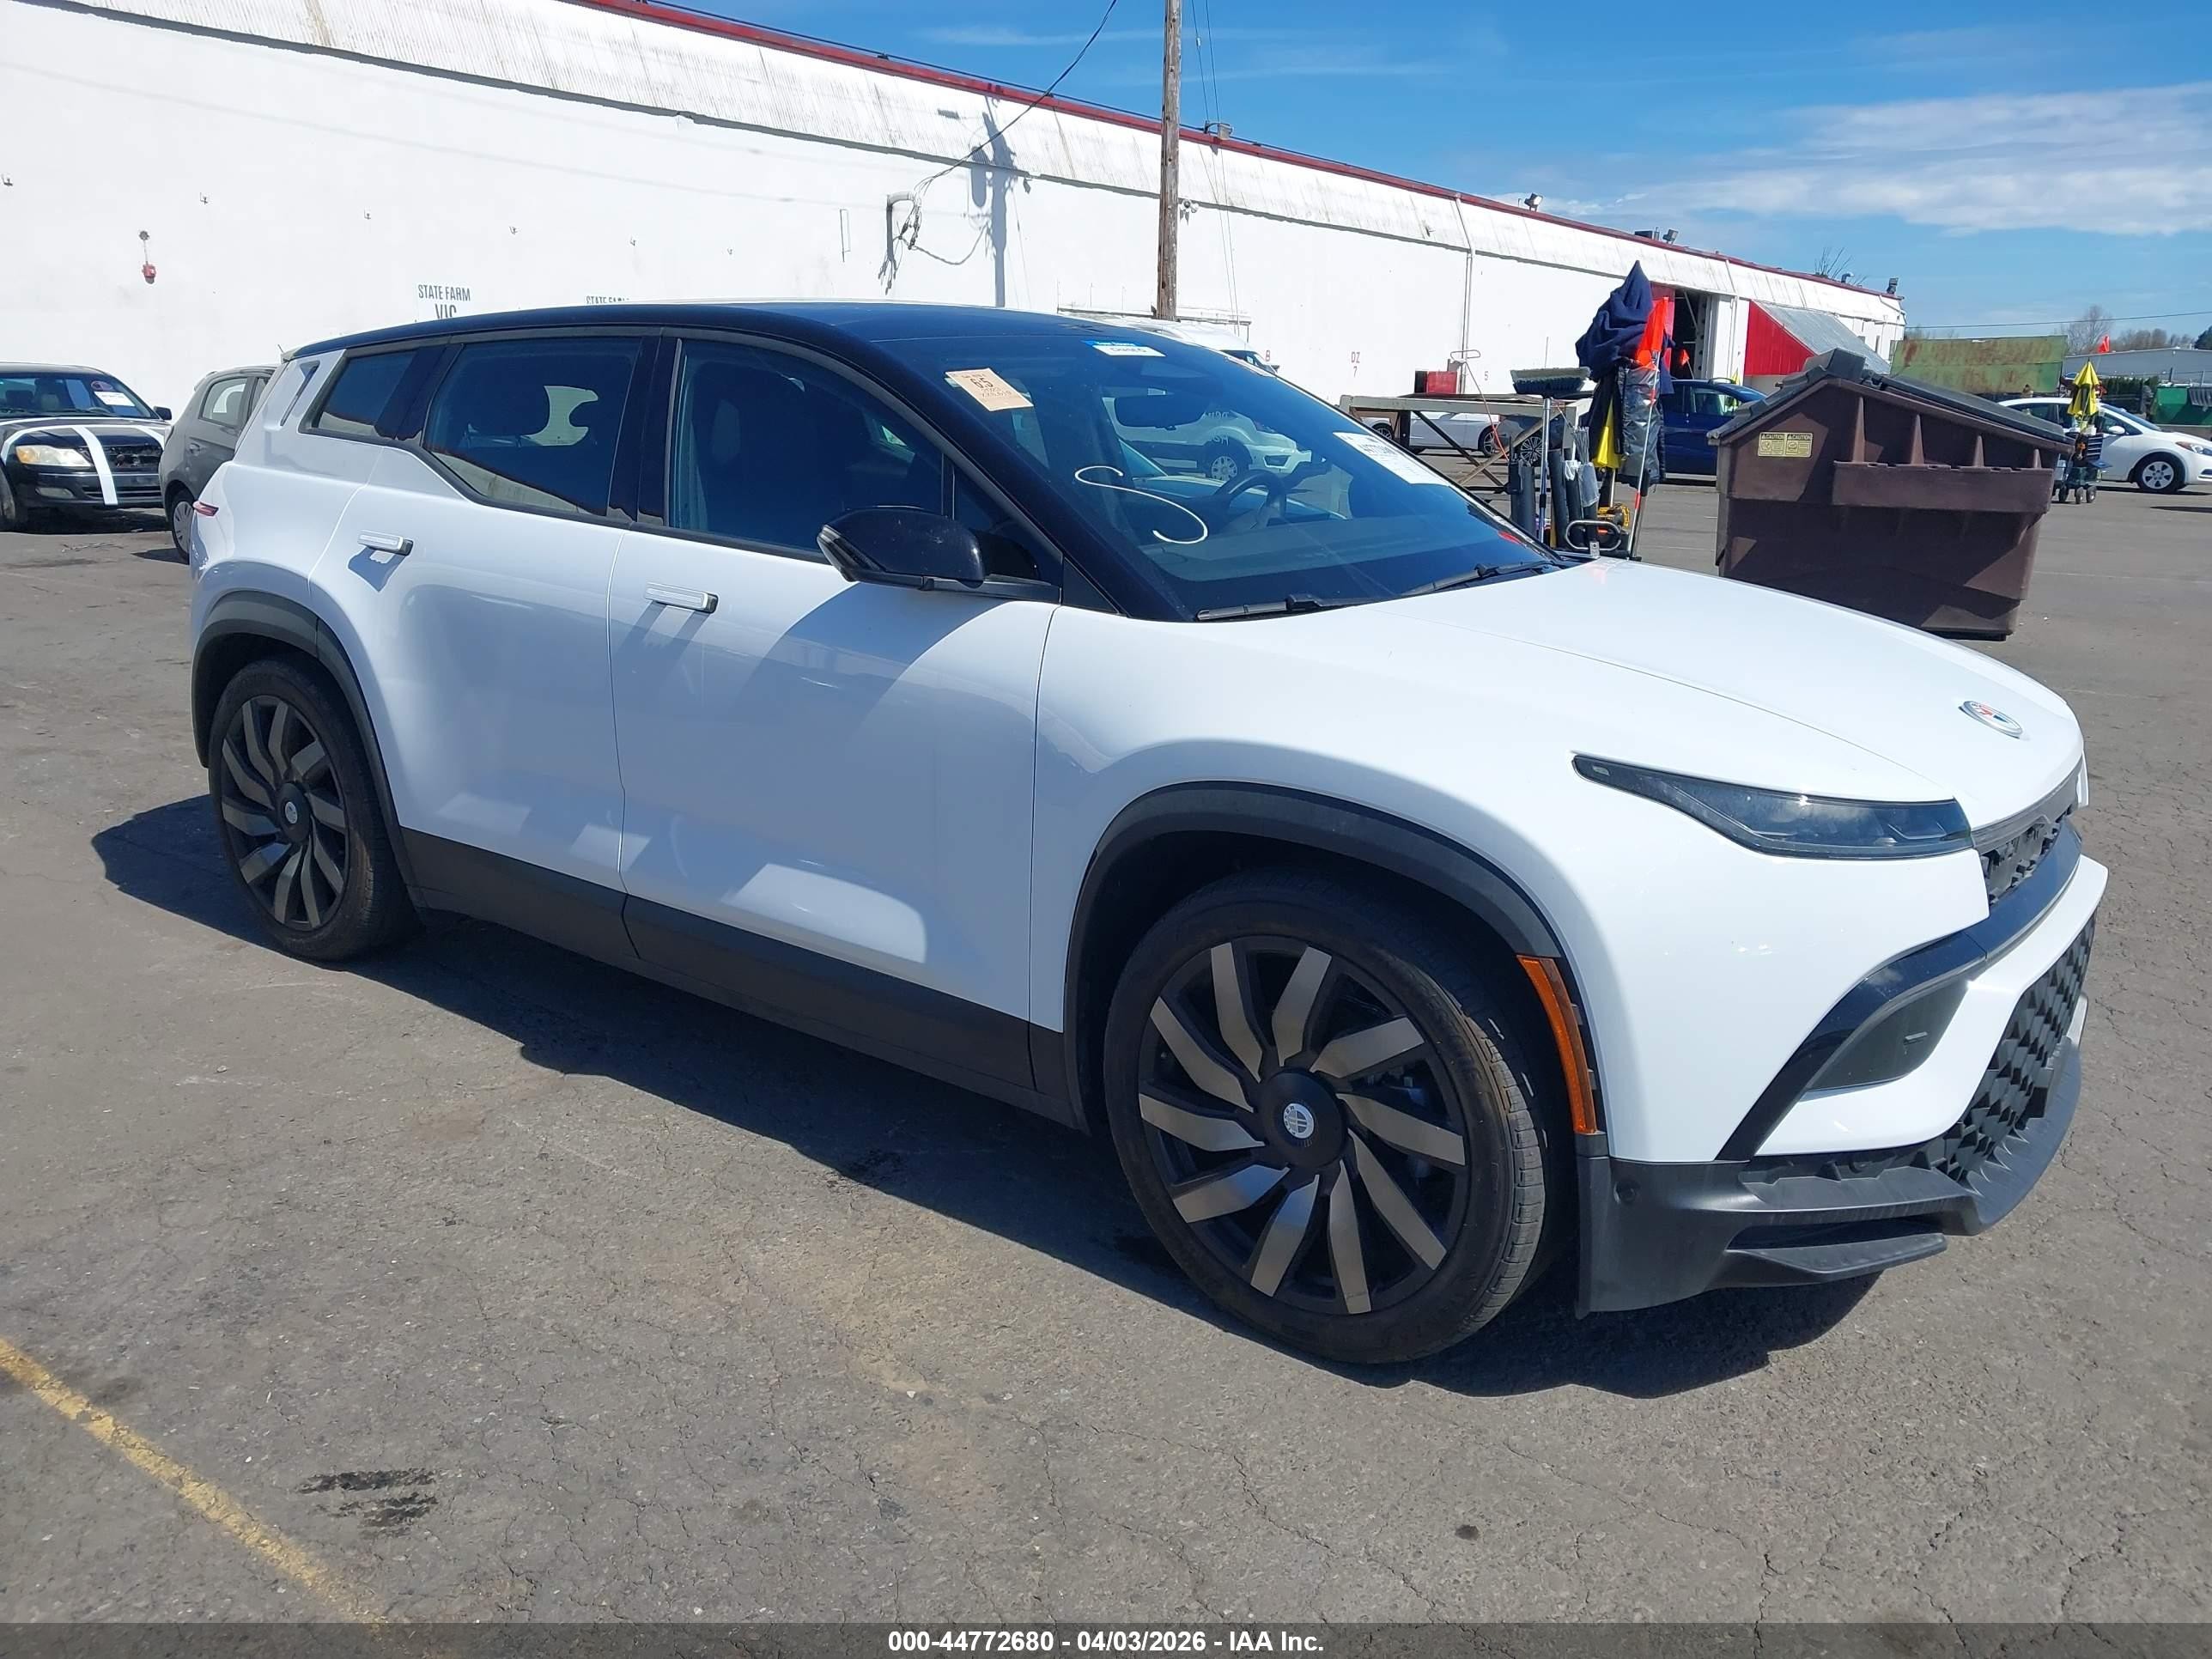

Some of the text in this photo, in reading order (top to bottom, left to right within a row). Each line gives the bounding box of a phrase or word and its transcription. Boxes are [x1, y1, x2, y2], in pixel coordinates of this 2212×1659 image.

[417, 284, 471, 301] STATE FARM
[1351, 351, 1360, 363] DZ
[1353, 366, 1358, 378] 7
